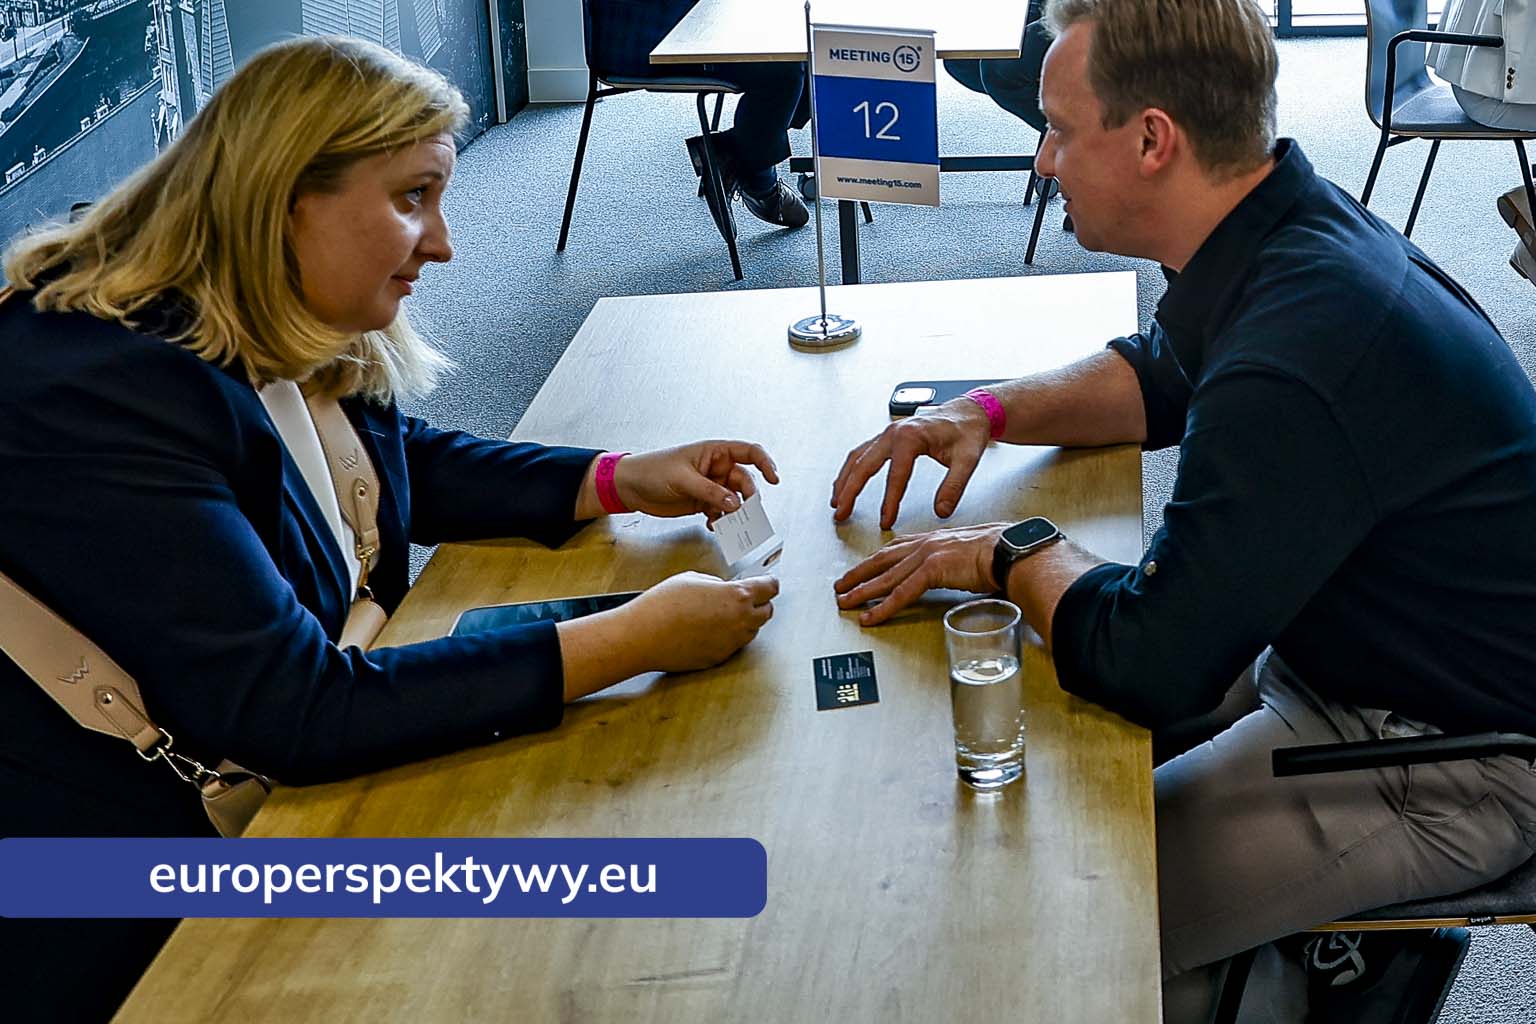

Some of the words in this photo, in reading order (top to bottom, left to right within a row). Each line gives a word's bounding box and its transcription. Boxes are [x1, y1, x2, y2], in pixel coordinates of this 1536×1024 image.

[829, 48, 891, 64] MEETING
[899, 53, 915, 65] 15
[853, 100, 901, 141] 12
[837, 175, 922, 189] www.meeting15.com
